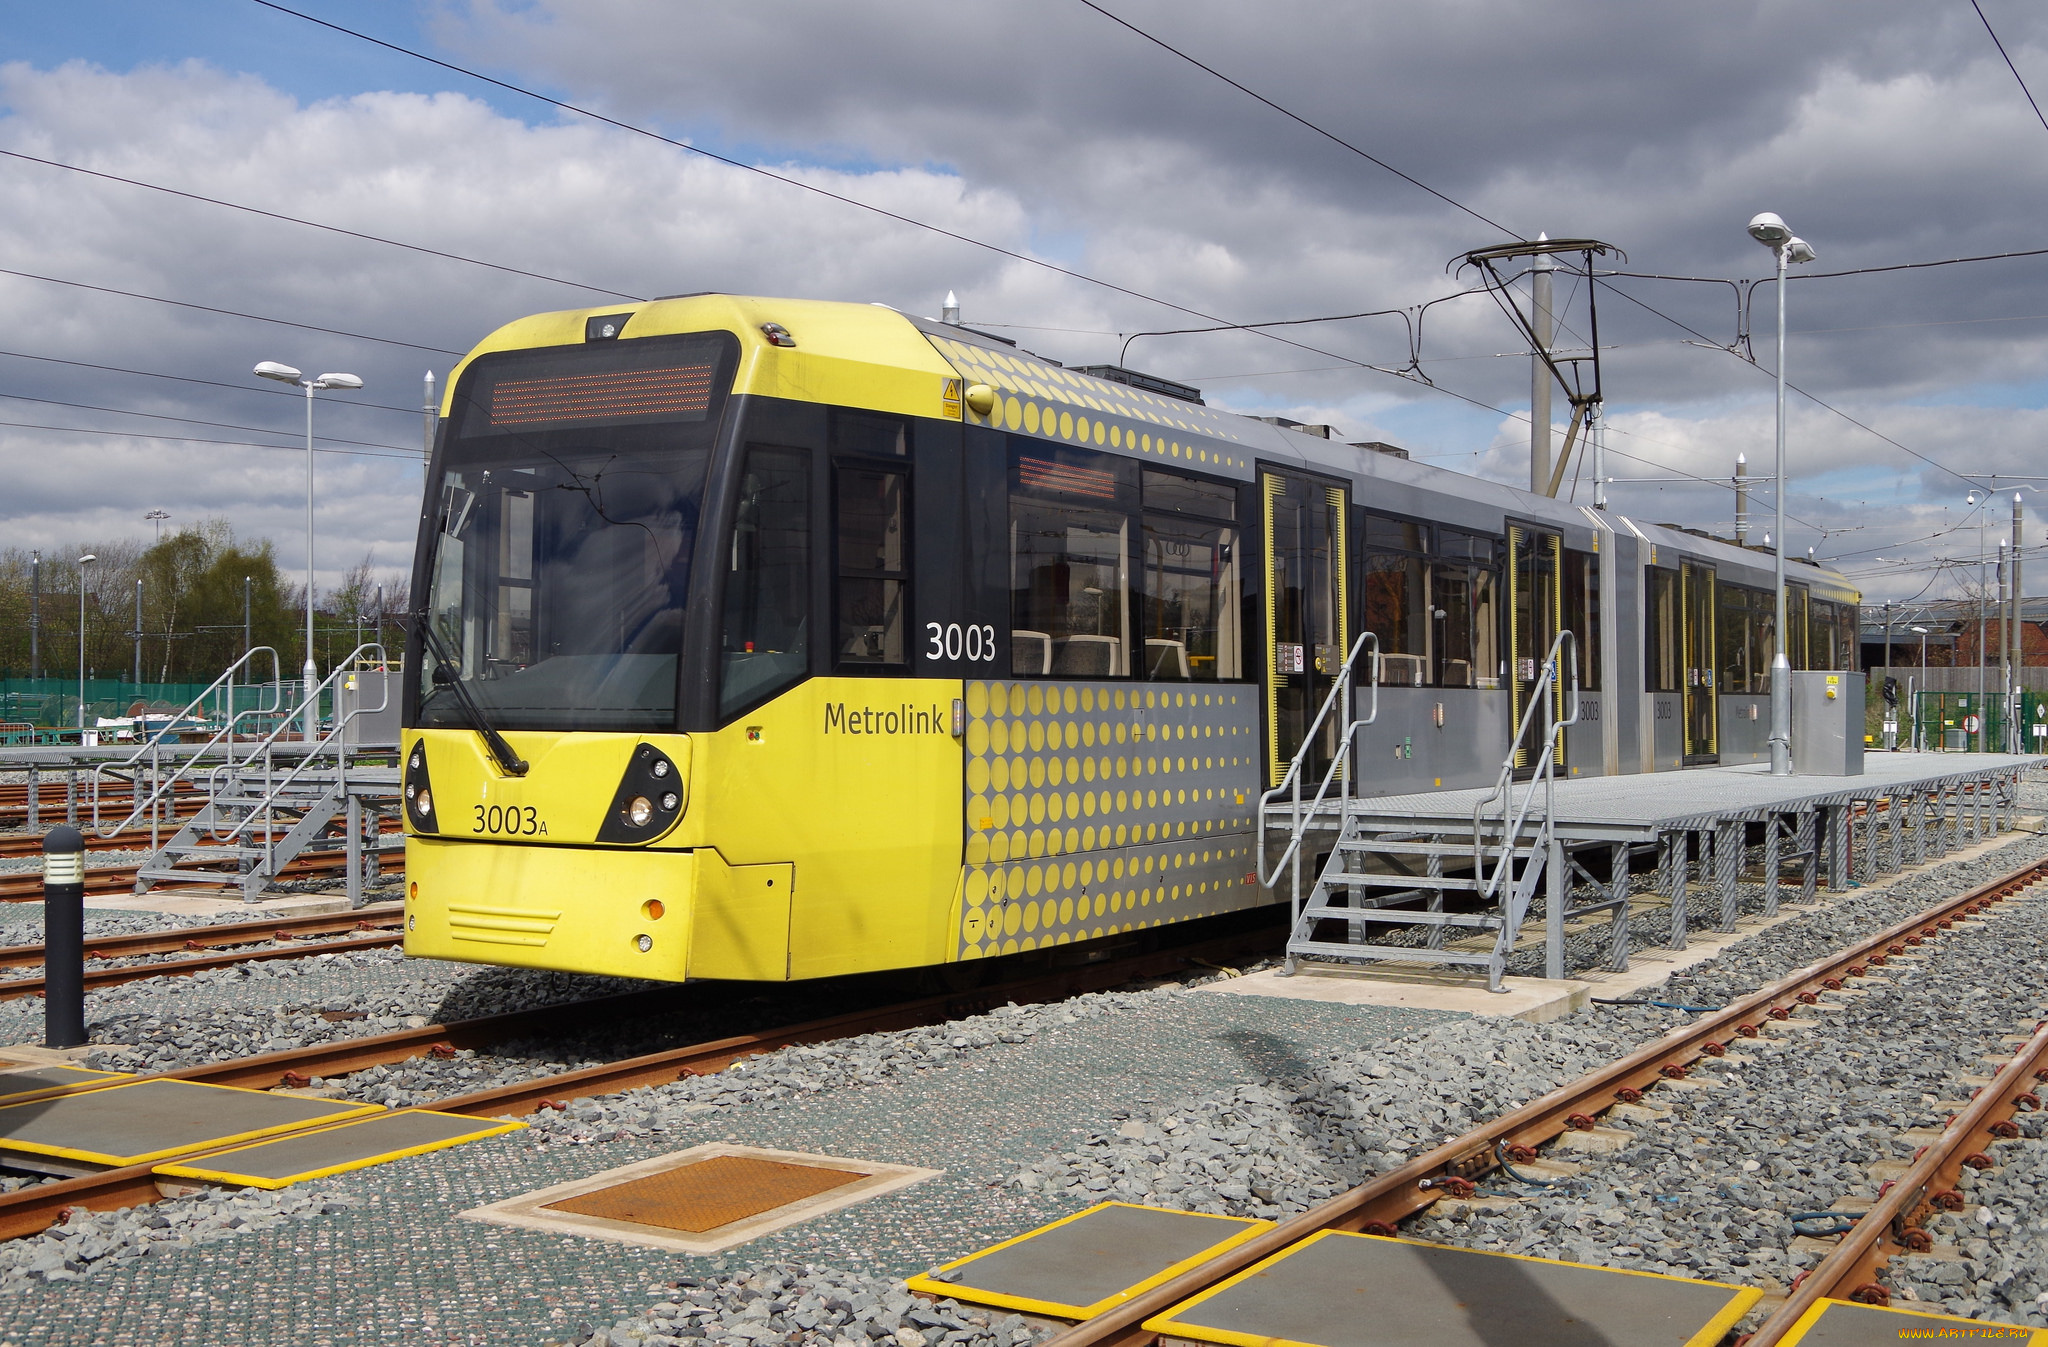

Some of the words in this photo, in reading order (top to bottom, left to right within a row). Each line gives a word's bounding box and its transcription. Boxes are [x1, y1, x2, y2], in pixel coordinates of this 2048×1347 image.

[926, 622, 996, 661] 3003
[824, 702, 944, 734] Metrolink
[1581, 700, 1599, 721] 3003
[1657, 701, 1672, 719] 3003
